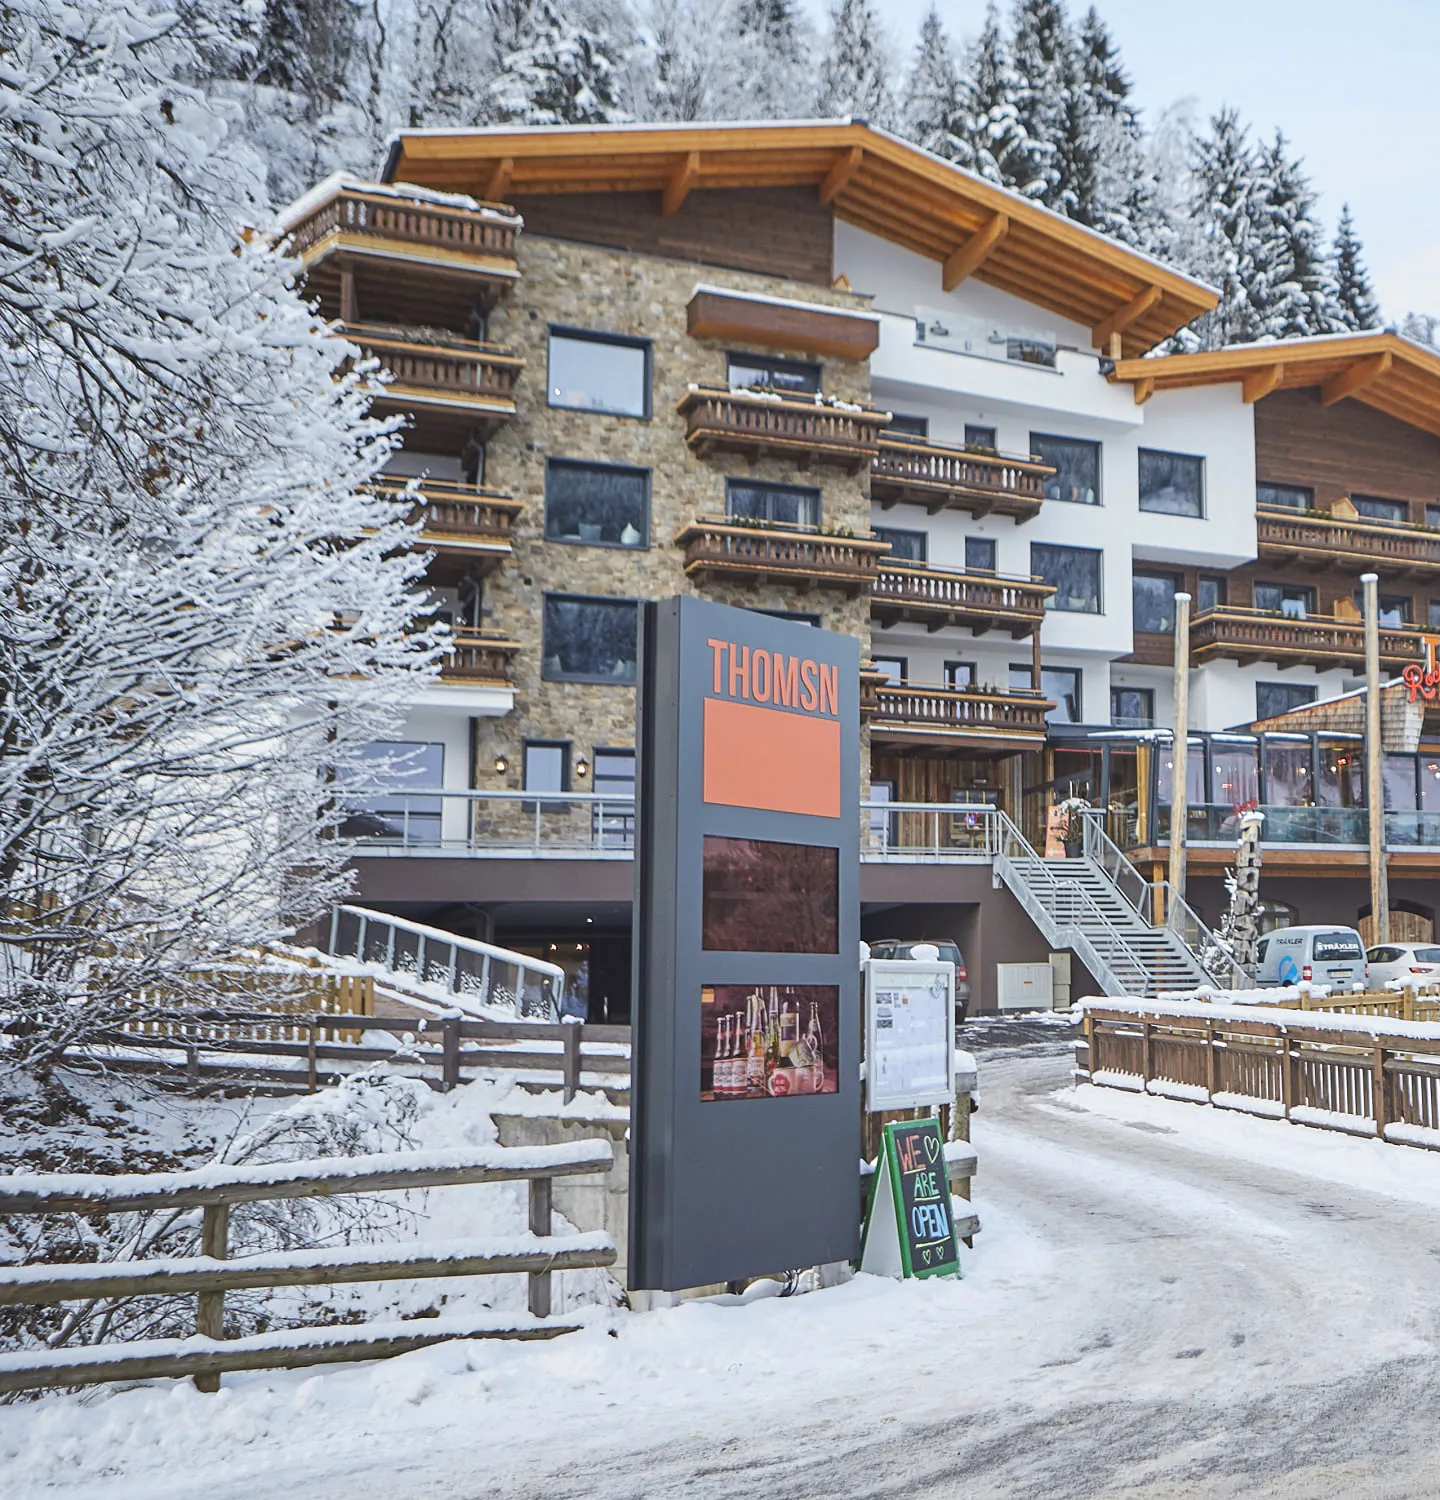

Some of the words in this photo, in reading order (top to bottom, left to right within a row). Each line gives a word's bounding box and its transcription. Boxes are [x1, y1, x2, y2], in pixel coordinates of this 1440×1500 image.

[707, 637, 839, 716] THOMSN
[897, 1134, 926, 1171] WE
[914, 1172, 940, 1197] ARE
[911, 1203, 950, 1238] OPEN
